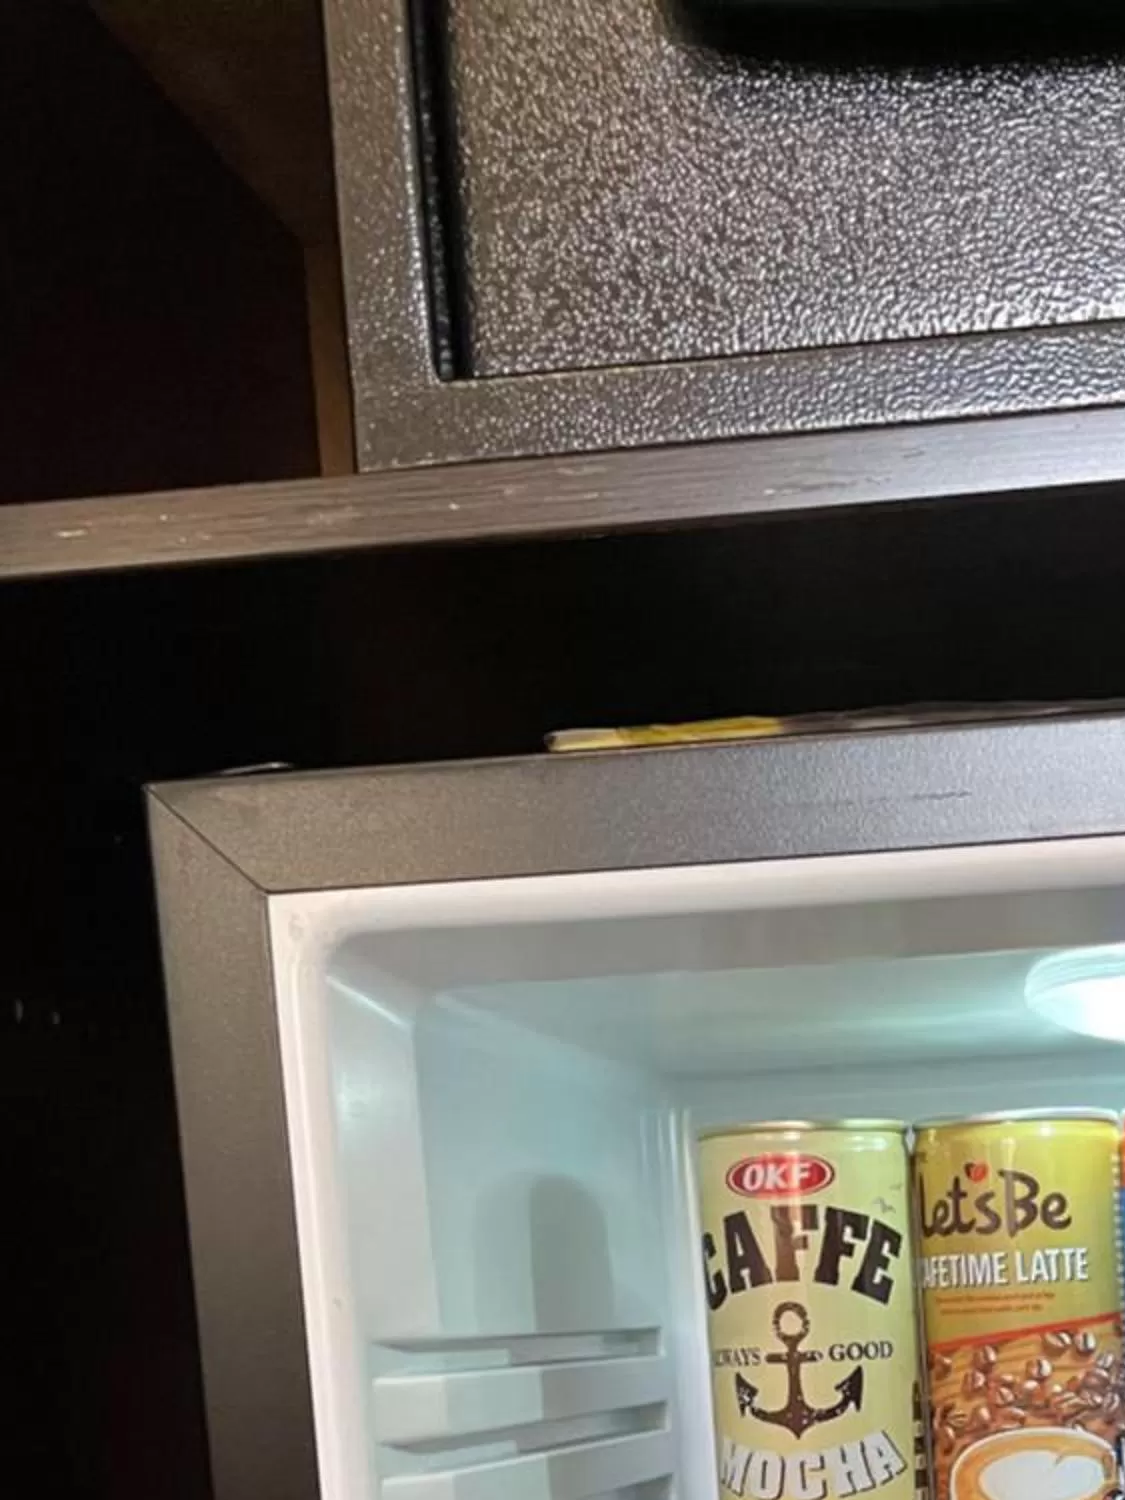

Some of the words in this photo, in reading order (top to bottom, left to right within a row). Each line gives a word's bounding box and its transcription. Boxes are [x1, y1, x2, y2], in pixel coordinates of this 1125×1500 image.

[743, 1162, 813, 1191] OKF
[998, 1168, 1072, 1238] Be
[1014, 1247, 1090, 1283] LATTE
[828, 1341, 894, 1362] GOOD
